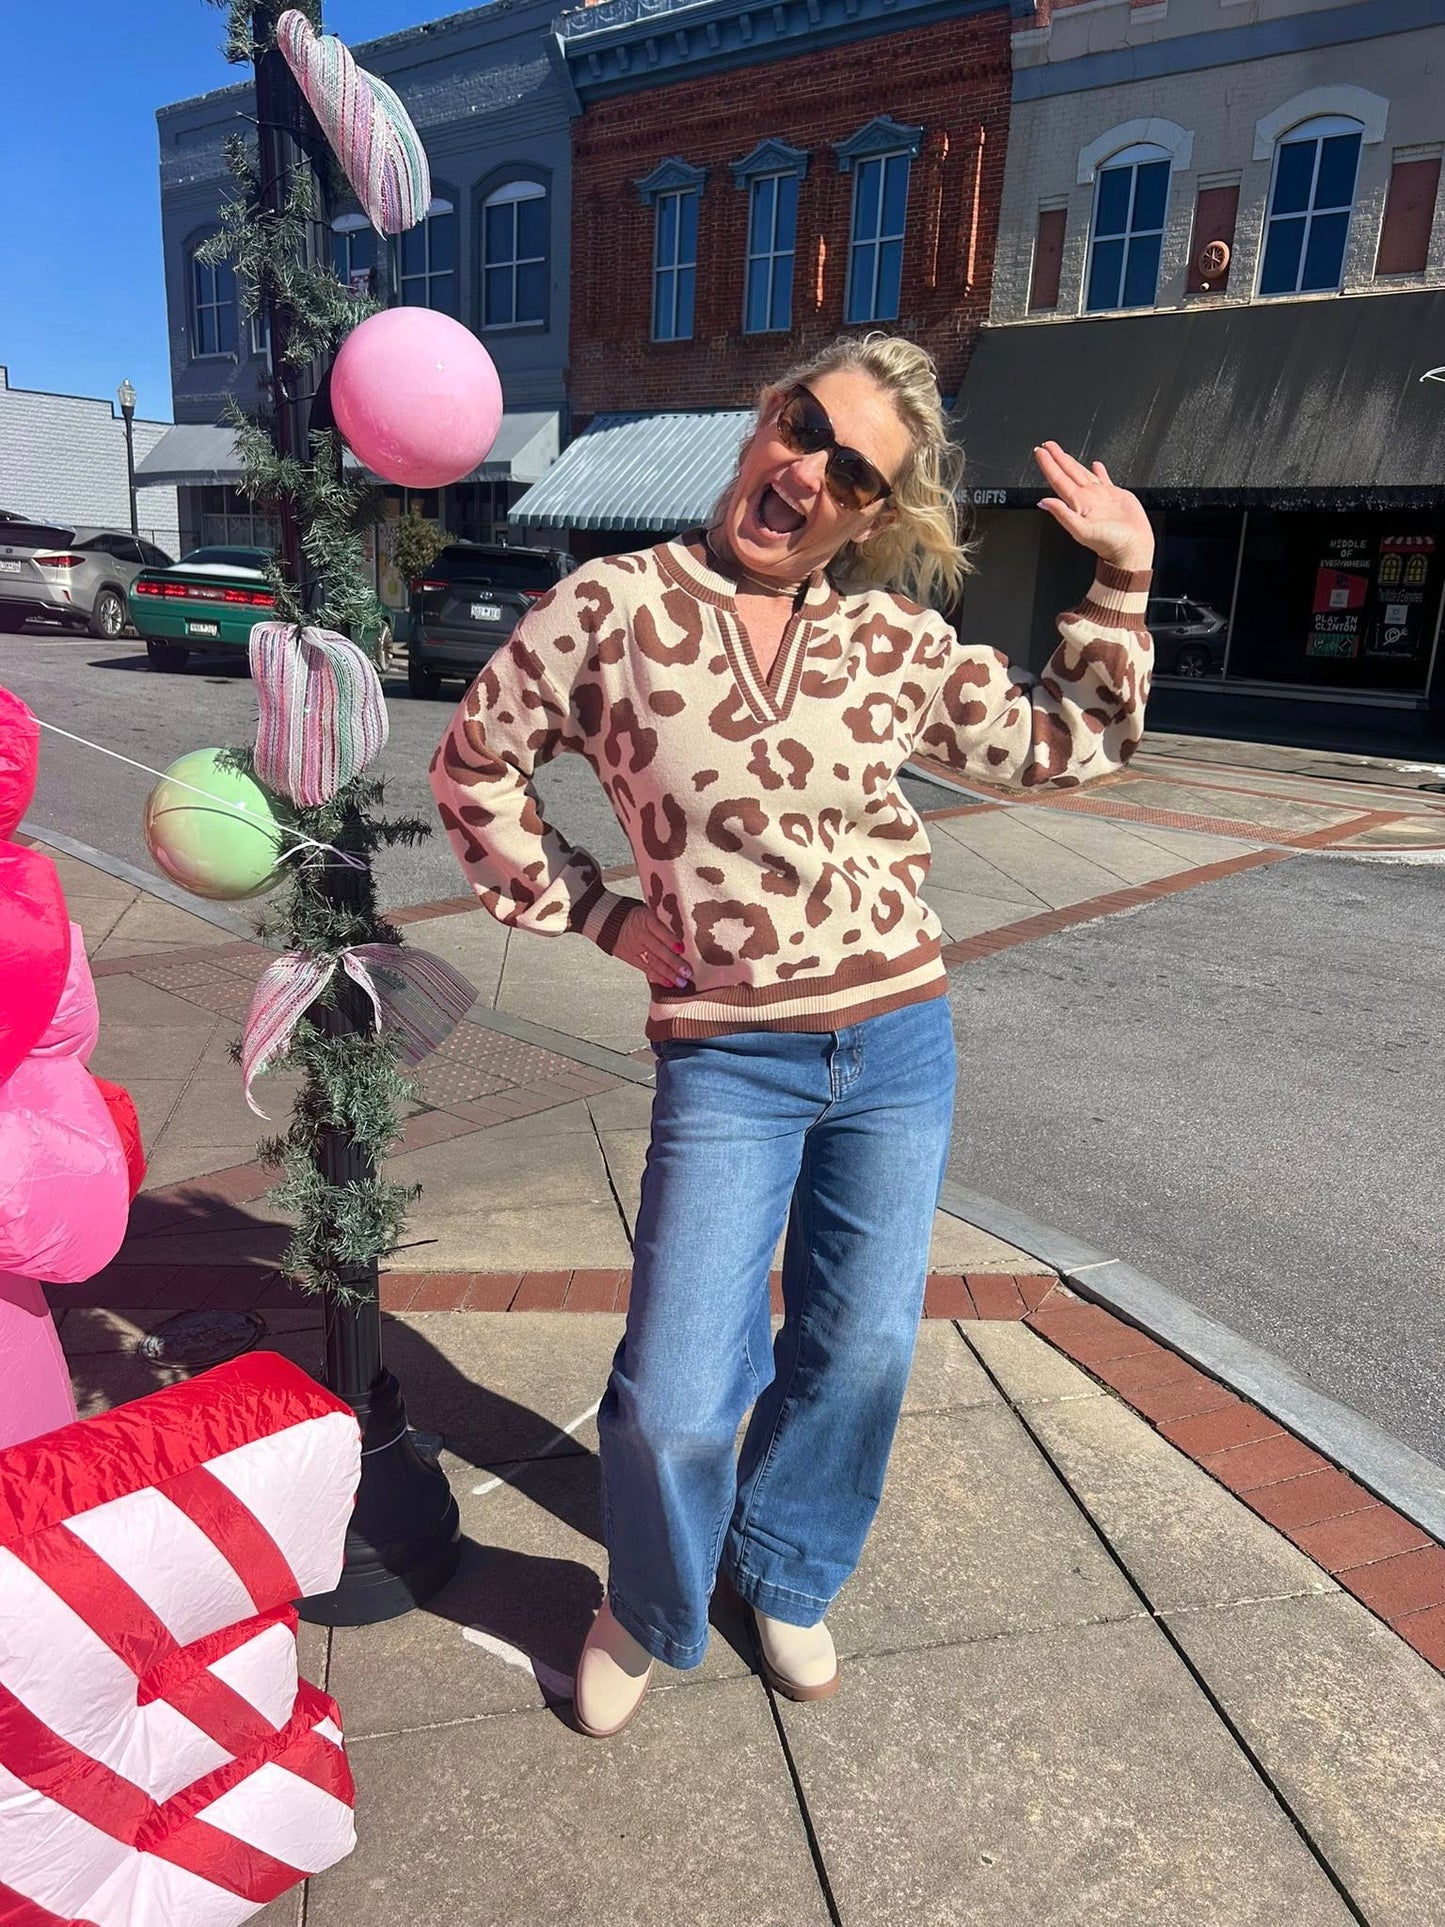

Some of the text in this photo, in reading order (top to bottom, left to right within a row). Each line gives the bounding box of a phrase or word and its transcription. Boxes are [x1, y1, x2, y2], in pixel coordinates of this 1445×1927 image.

[973, 488, 1007, 504] GIFTS
[1329, 538, 1367, 549] MIDDLE
[1339, 548, 1354, 558] OF
[1320, 559, 1371, 568] EVERYWHERE
[1314, 614, 1358, 625] PLAY IN
[1314, 622, 1357, 632] CLINTON
